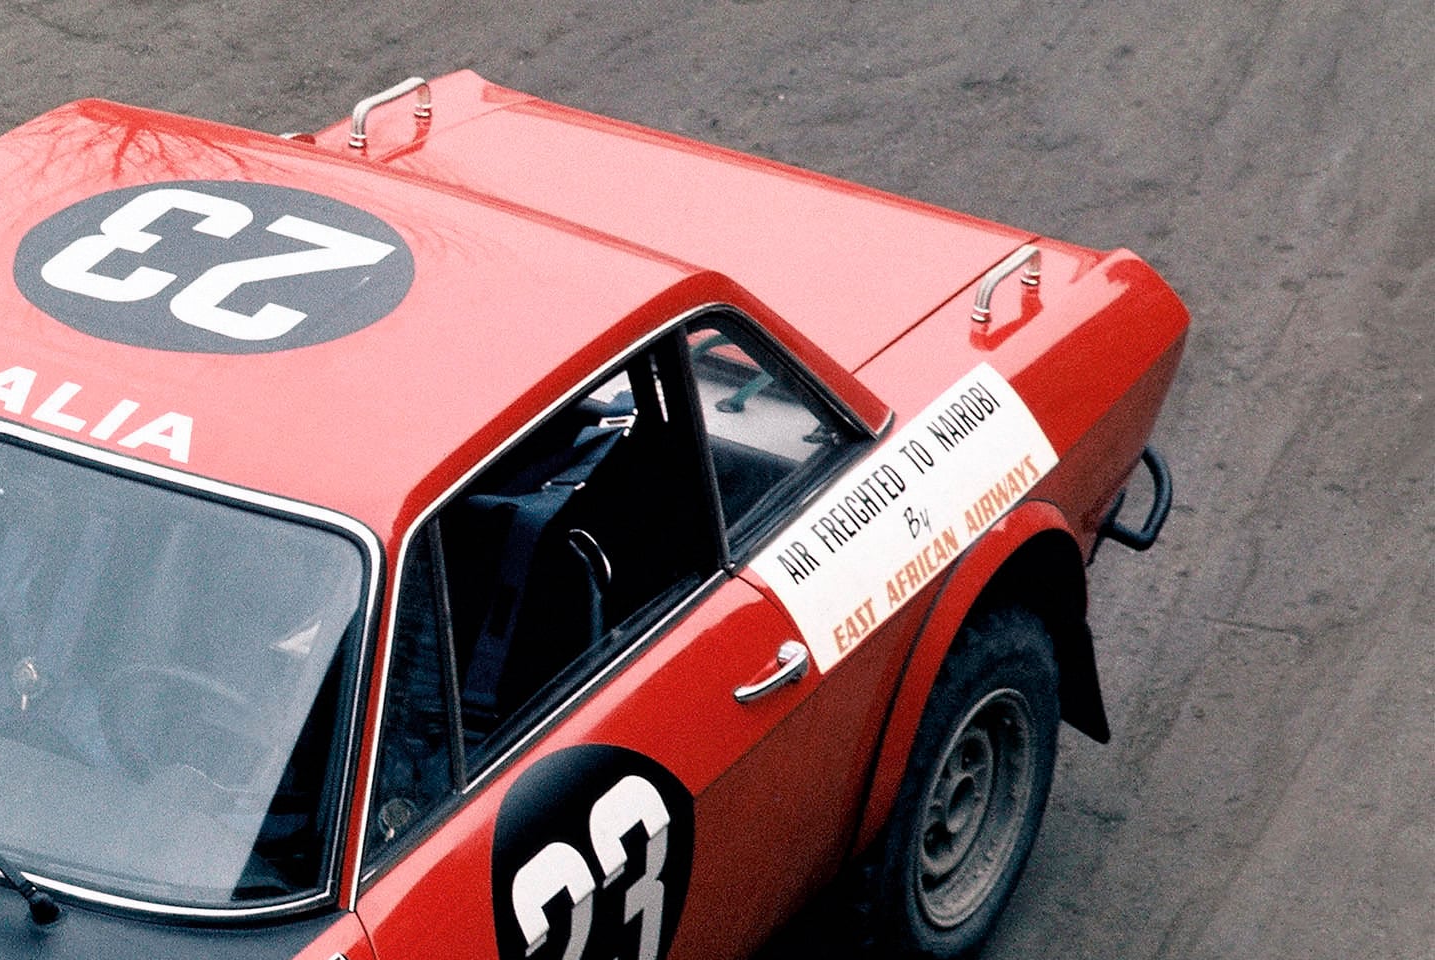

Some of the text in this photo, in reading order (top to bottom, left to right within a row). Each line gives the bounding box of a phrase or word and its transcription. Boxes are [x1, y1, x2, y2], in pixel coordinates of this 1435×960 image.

[41, 188, 397, 341] 23
[776, 381, 1001, 585] AIR FREIGHTED TO NAIROBI
[832, 454, 1040, 655] EAST AFRICAN AIRWAYS
